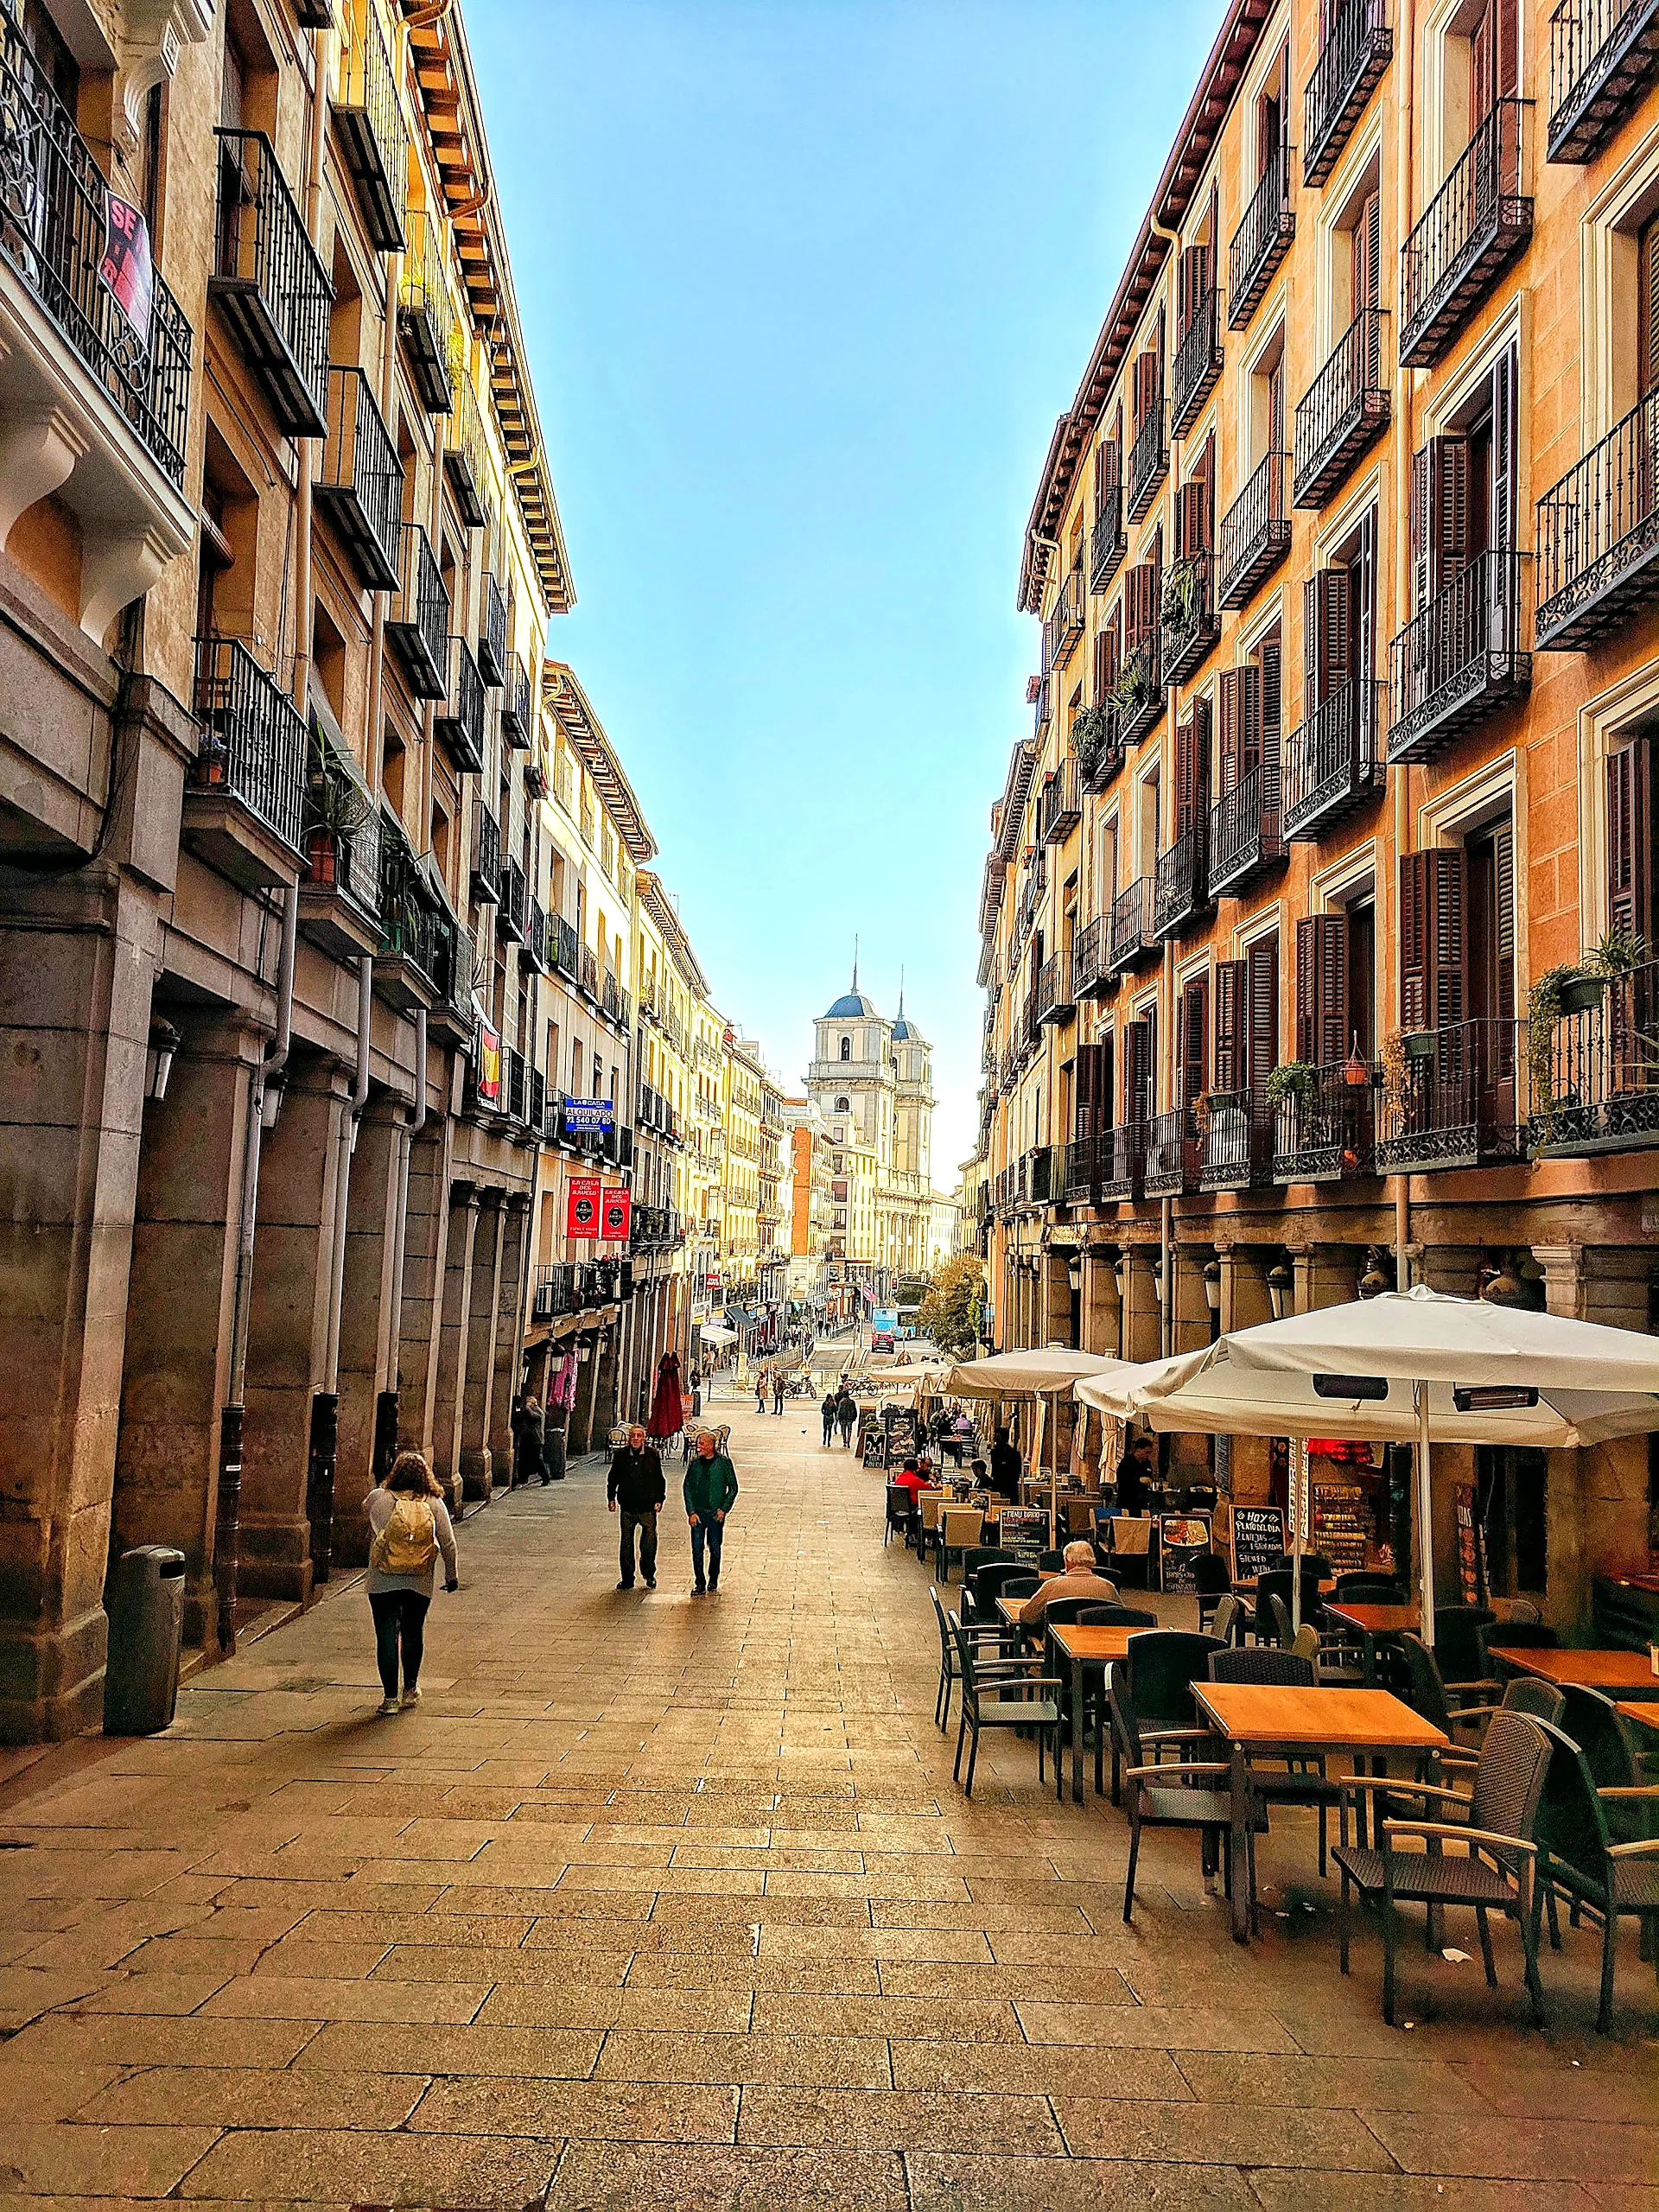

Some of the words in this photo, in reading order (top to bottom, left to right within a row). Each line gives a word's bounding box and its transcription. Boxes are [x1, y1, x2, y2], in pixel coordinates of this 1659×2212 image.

[111, 200, 137, 240] SE
[1247, 1512, 1268, 1523] HOY
[1236, 1521, 1256, 1530] PLATO
[1257, 1523, 1268, 1532] DEL
[1236, 1532, 1268, 1543] LENTEJAS
